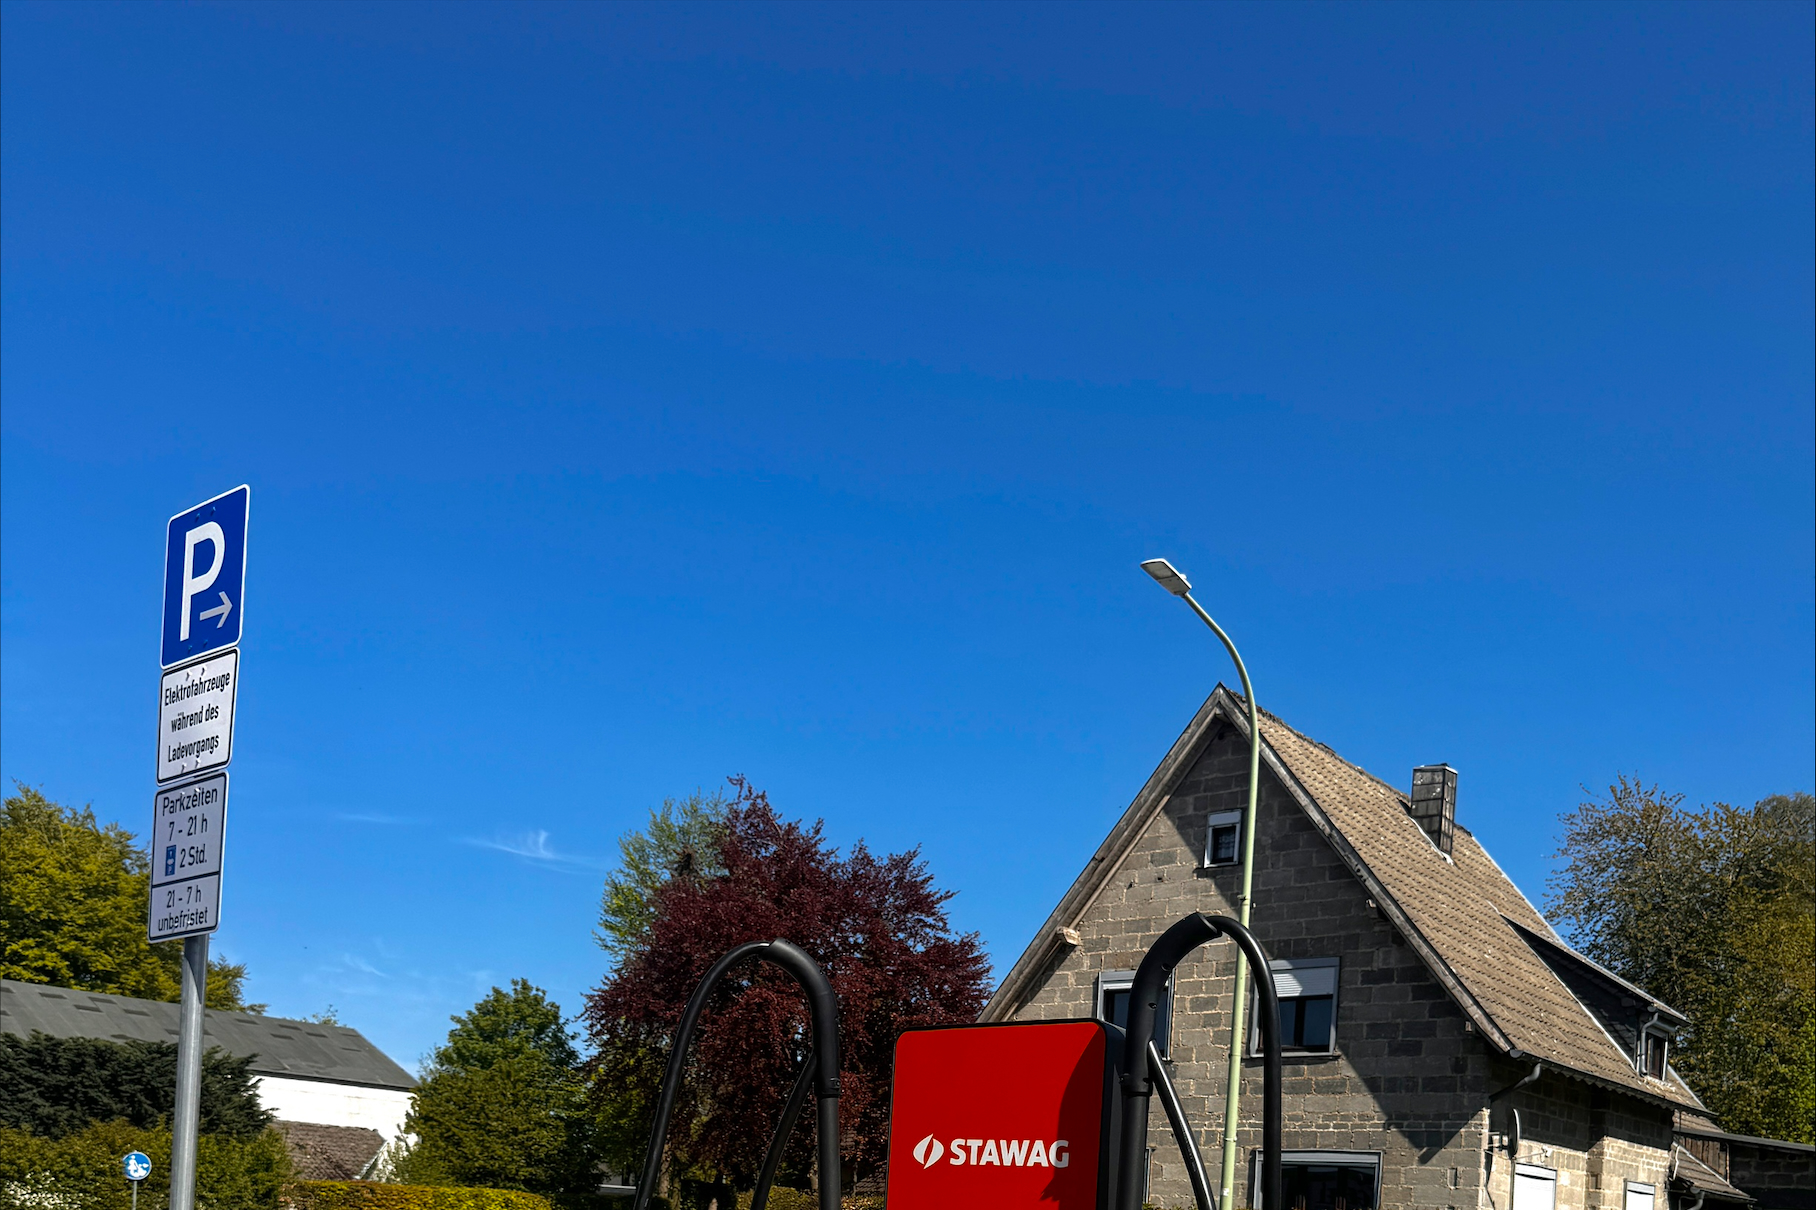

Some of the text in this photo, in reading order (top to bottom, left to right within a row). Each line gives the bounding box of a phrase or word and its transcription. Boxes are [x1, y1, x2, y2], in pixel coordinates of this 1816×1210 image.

[180, 521, 225, 641] P
[165, 672, 230, 706] Elektrofahrzeuge
[171, 703, 219, 732] während des
[168, 735, 219, 763] Ladevorgangs
[162, 788, 218, 816] Parkzeiten
[168, 821, 175, 842] 7
[187, 815, 197, 837] 21
[201, 813, 208, 834] h
[179, 848, 186, 868] 2
[188, 844, 208, 867] Std.
[166, 890, 175, 909] 21
[187, 886, 193, 905] 7
[196, 885, 202, 903] h
[158, 906, 208, 932] unbefristet
[949, 1138, 1070, 1168] STAWAG
